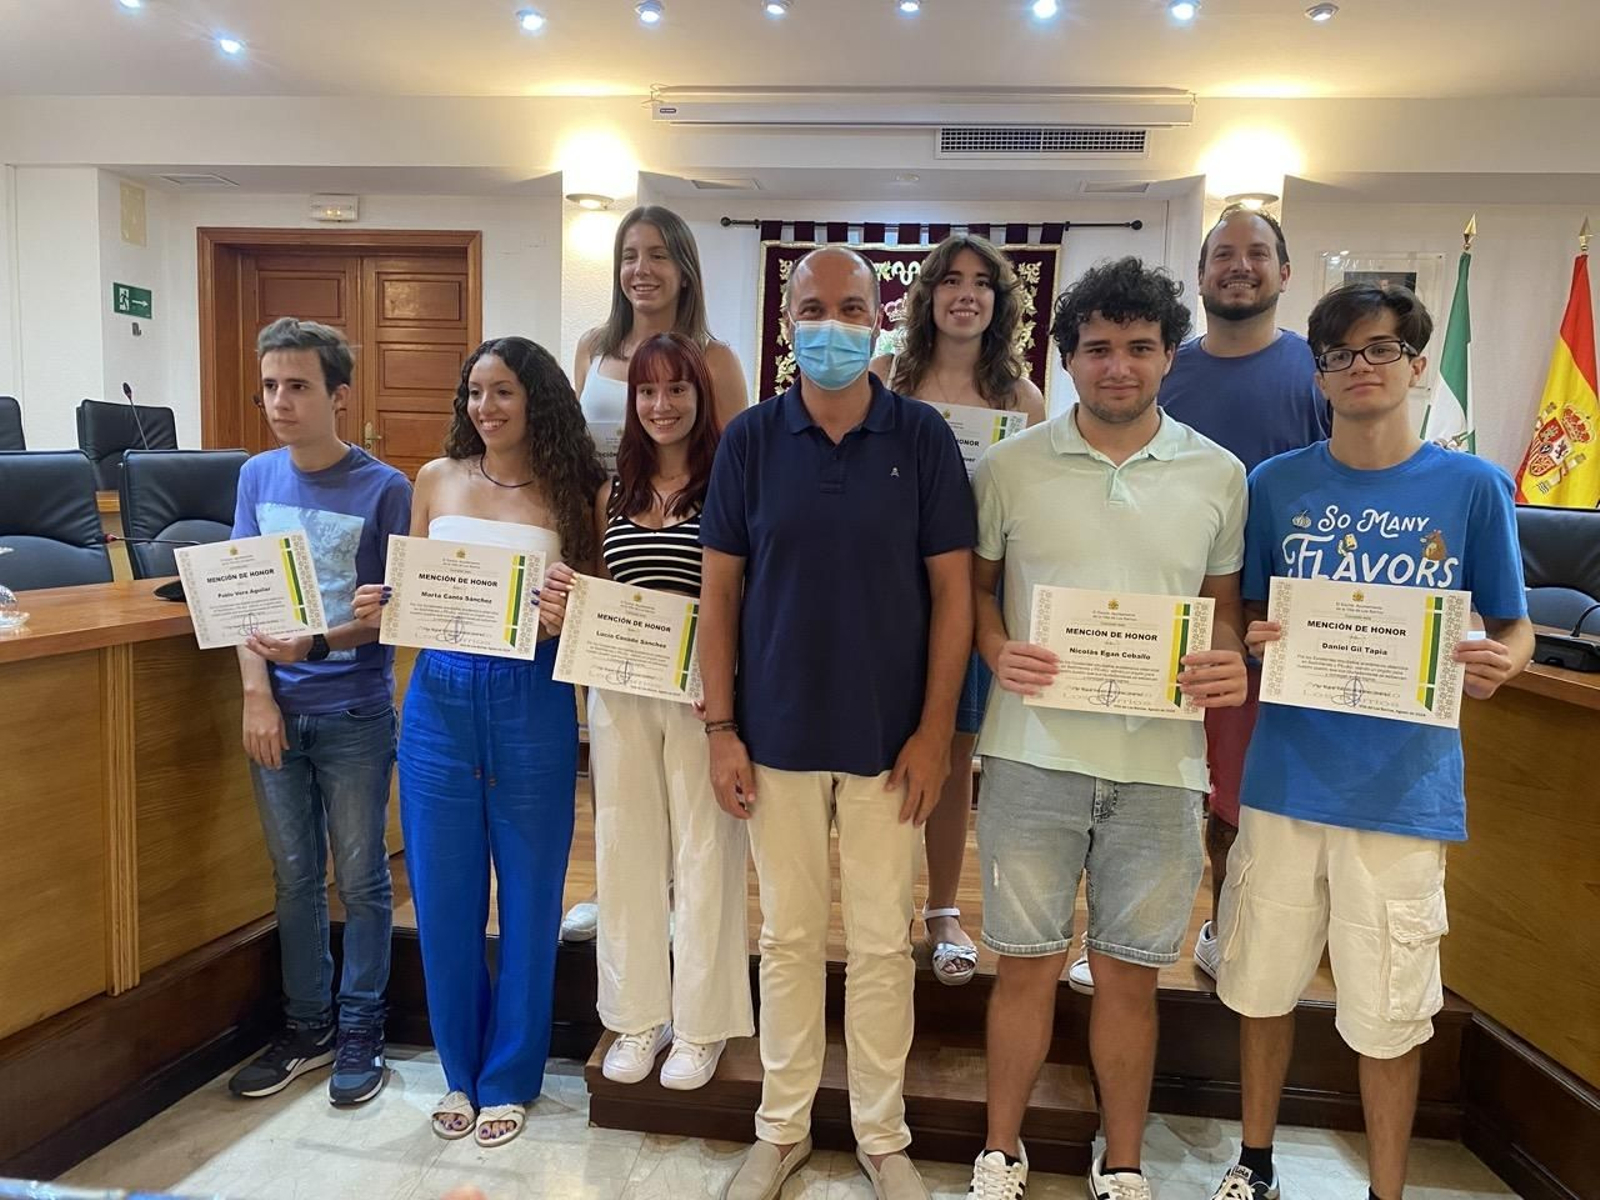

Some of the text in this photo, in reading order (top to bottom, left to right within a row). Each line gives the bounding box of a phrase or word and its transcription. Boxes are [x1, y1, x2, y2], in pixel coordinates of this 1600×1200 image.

[957, 438, 980, 446] ONOR
[1282, 533, 1459, 588] FLAVORS
[250, 568, 275, 577] HONOR
[418, 573, 456, 583] MENCIÓN
[470, 579, 498, 587] HONOR
[597, 612, 632, 625] MENCIÓN
[644, 622, 671, 633] HONOR
[1307, 619, 1352, 632] MENCIÓN
[1355, 624, 1368, 633] DE
[1370, 627, 1407, 637] HONOR
[1065, 627, 1108, 637] MENCIÓN
[1125, 632, 1158, 641] HONOR
[1069, 647, 1098, 656] Nicolás
[1321, 642, 1388, 656] Daniel Gil Tapia
